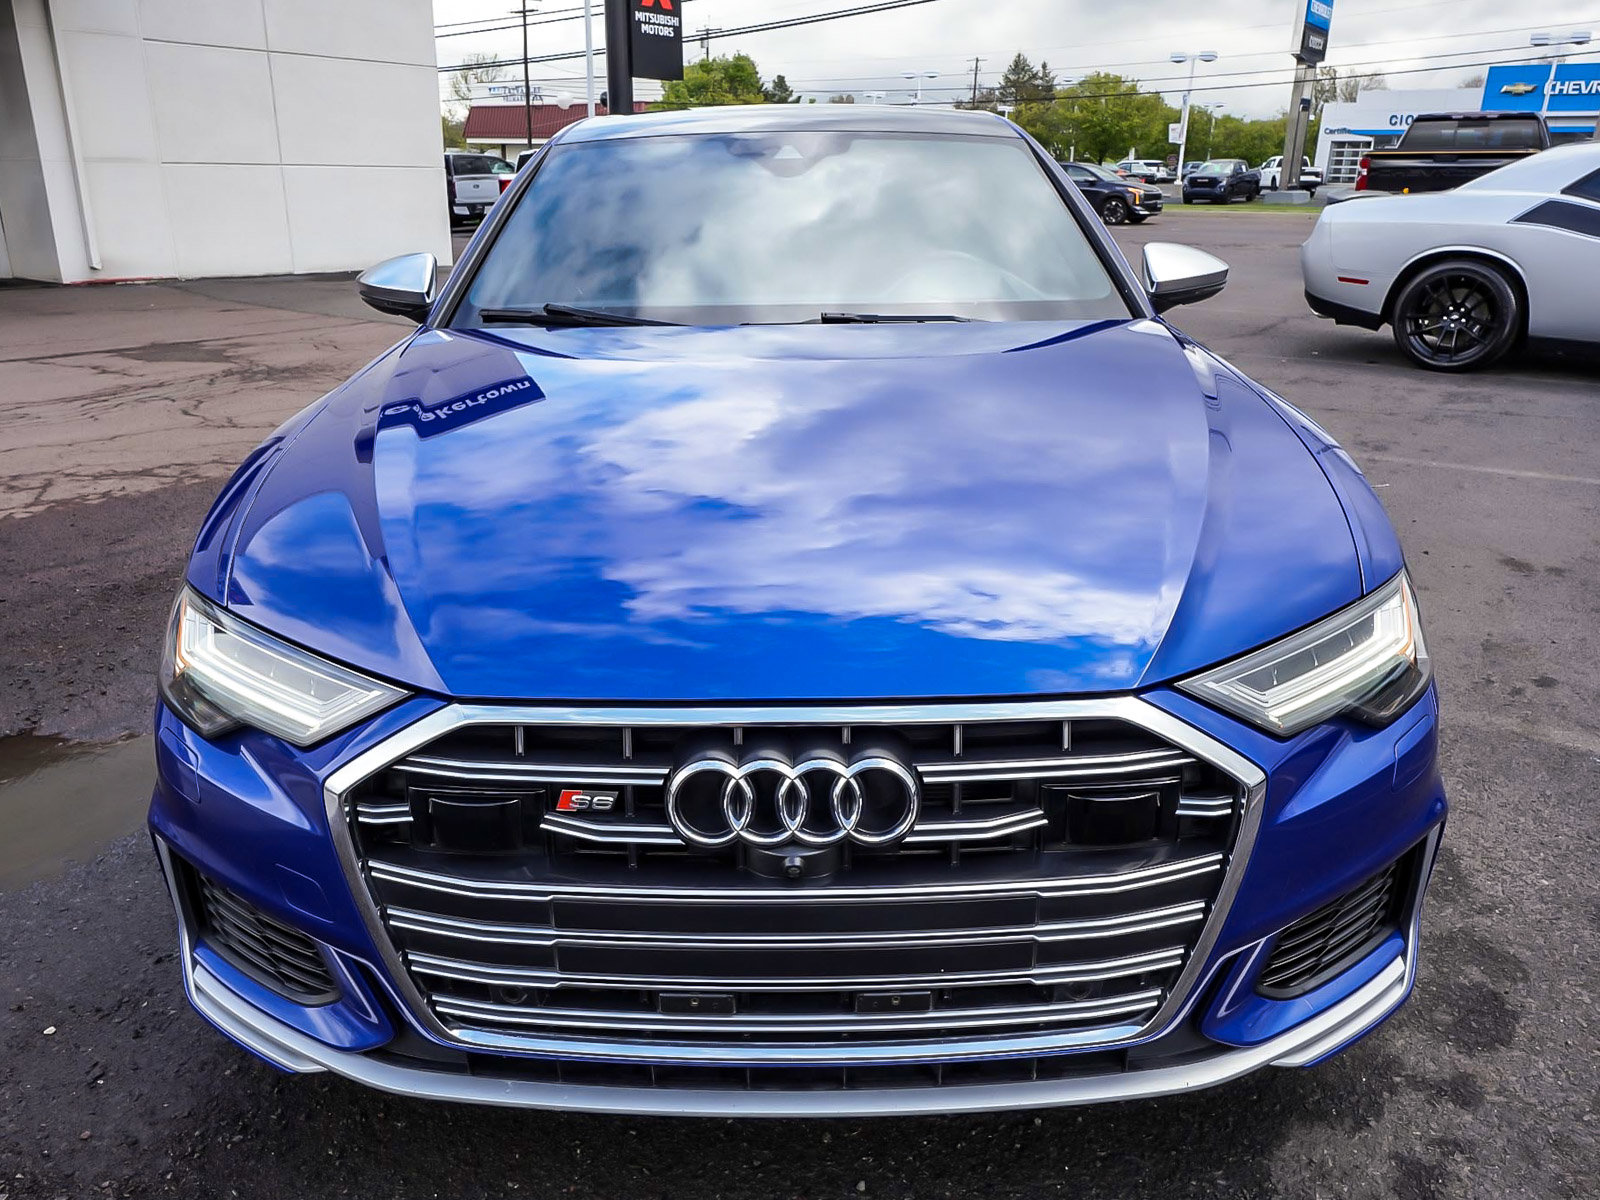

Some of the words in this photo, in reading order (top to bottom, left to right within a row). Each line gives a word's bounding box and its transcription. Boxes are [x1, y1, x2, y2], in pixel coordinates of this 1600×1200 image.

[634, 10, 680, 27] MITSUBISHI
[641, 23, 675, 37] MOTORS
[569, 795, 614, 810] S6
